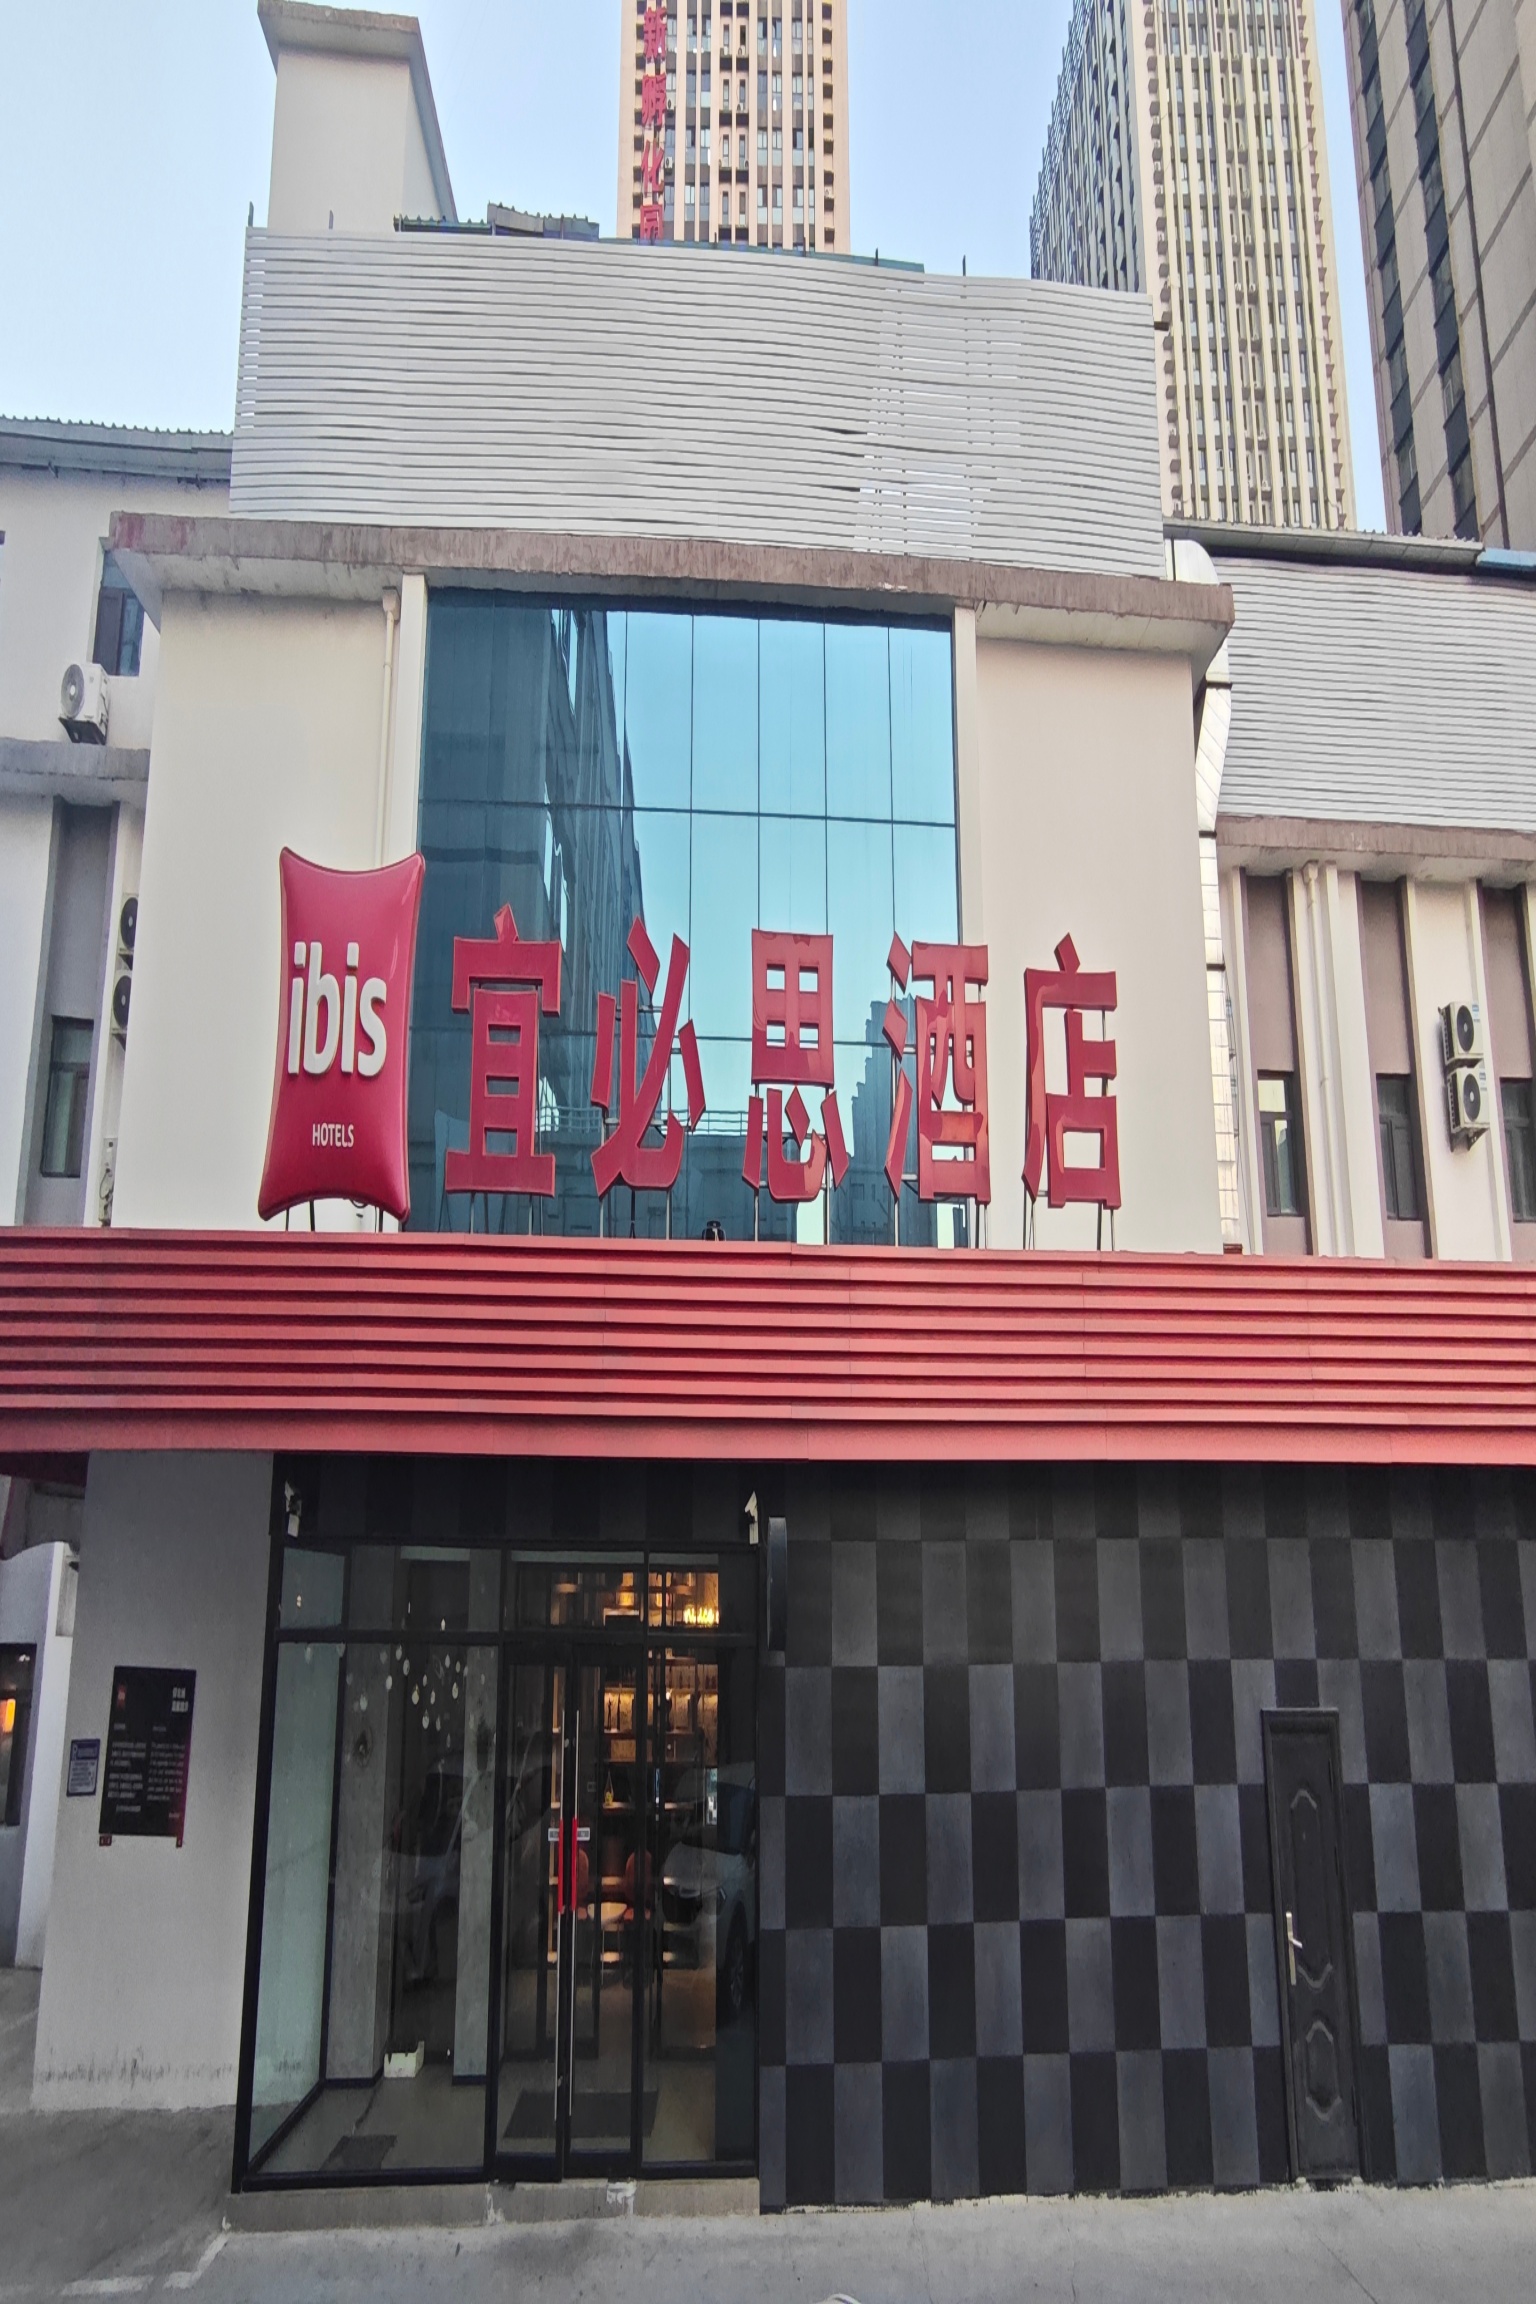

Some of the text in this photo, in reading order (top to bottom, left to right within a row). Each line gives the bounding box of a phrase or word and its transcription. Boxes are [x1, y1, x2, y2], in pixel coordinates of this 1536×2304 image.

[287, 941, 387, 1077] ibis
[445, 903, 1121, 1210] 宜必思酒店
[312, 1122, 355, 1148] HOTELS
